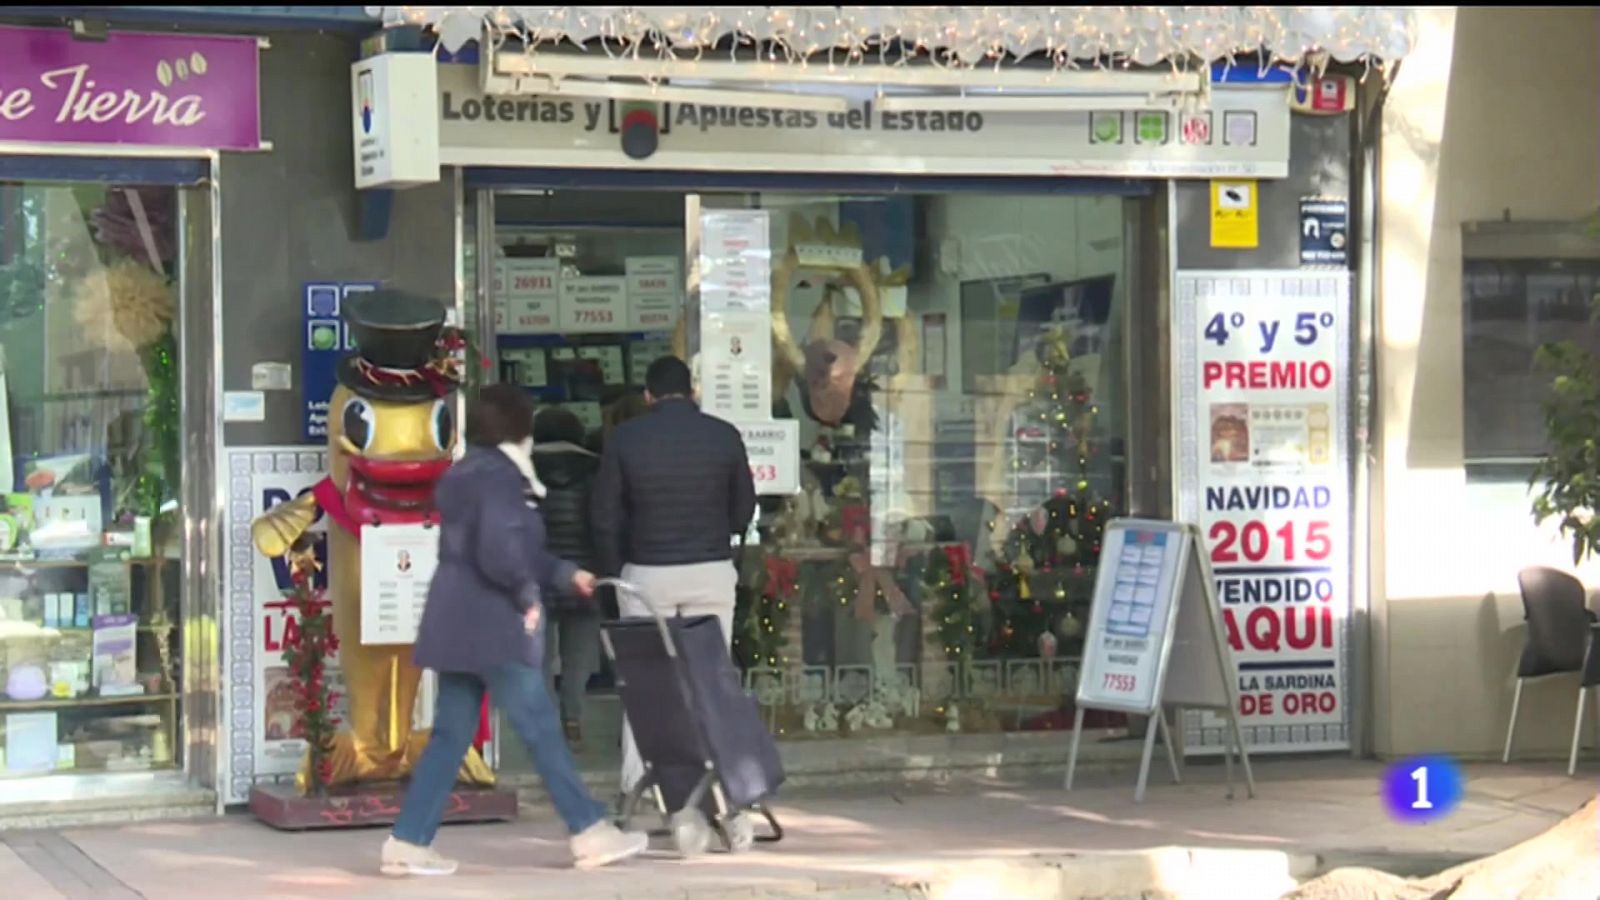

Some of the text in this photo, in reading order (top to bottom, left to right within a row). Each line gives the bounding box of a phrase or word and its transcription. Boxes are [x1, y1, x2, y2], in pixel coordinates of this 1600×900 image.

[0, 64, 206, 126] e Tierra
[585, 102, 601, 131] y
[676, 102, 818, 131] Apuestas
[827, 100, 872, 131] del
[881, 108, 984, 132] Estado
[1204, 312, 1335, 354] 4º y 5º
[1203, 360, 1333, 390] PREMIO
[1206, 485, 1331, 511] NAVIDAD
[1209, 520, 1333, 563] 2015
[1239, 673, 1337, 692] LA SARDINA
[1239, 692, 1337, 716] DE ORO
